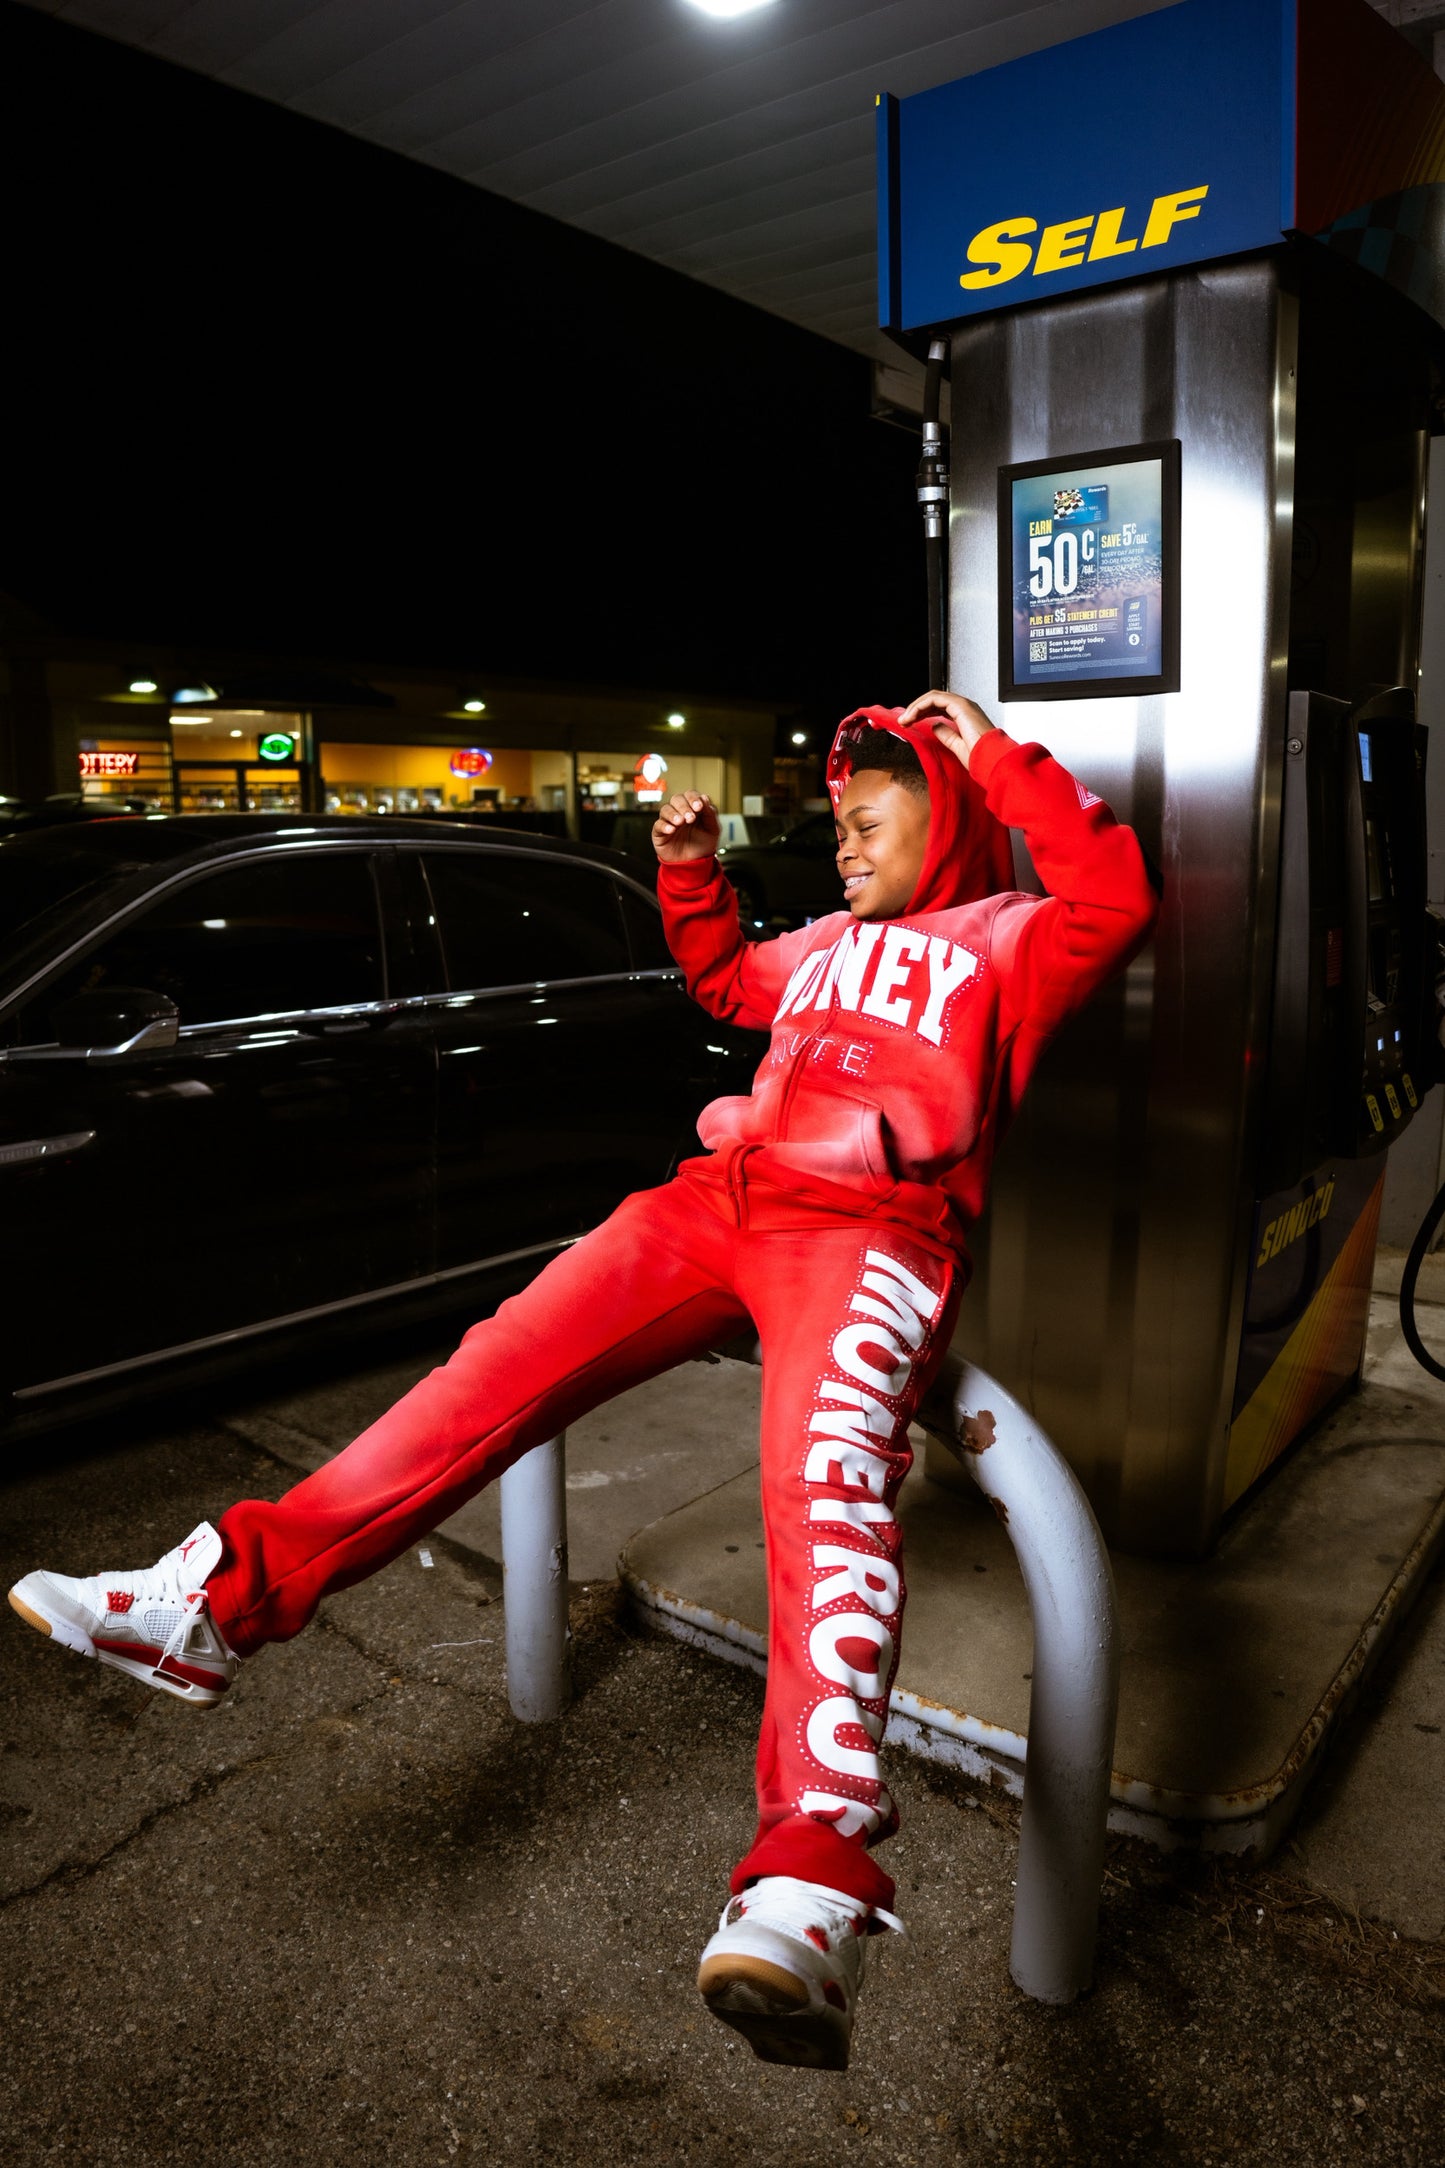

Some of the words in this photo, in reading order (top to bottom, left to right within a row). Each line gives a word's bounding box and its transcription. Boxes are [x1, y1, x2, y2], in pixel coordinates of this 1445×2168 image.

[960, 185, 1209, 290] SELF
[1030, 519, 1052, 537] EARN
[1101, 533, 1122, 549] SAVE
[1030, 616, 1043, 625] PLUS
[1044, 614, 1054, 624] GET
[1055, 607, 1066, 622] $5
[1067, 610, 1097, 621] STATEMENT
[1030, 628, 1045, 637] AFTER
[1045, 626, 1064, 636] MAKING
[1065, 626, 1069, 634] 3
[1069, 623, 1098, 633] PURCHASES
[1064, 645, 1085, 653] saving!
[1070, 638, 1087, 646] apply
[1256, 1180, 1336, 1269] SUNOCO
